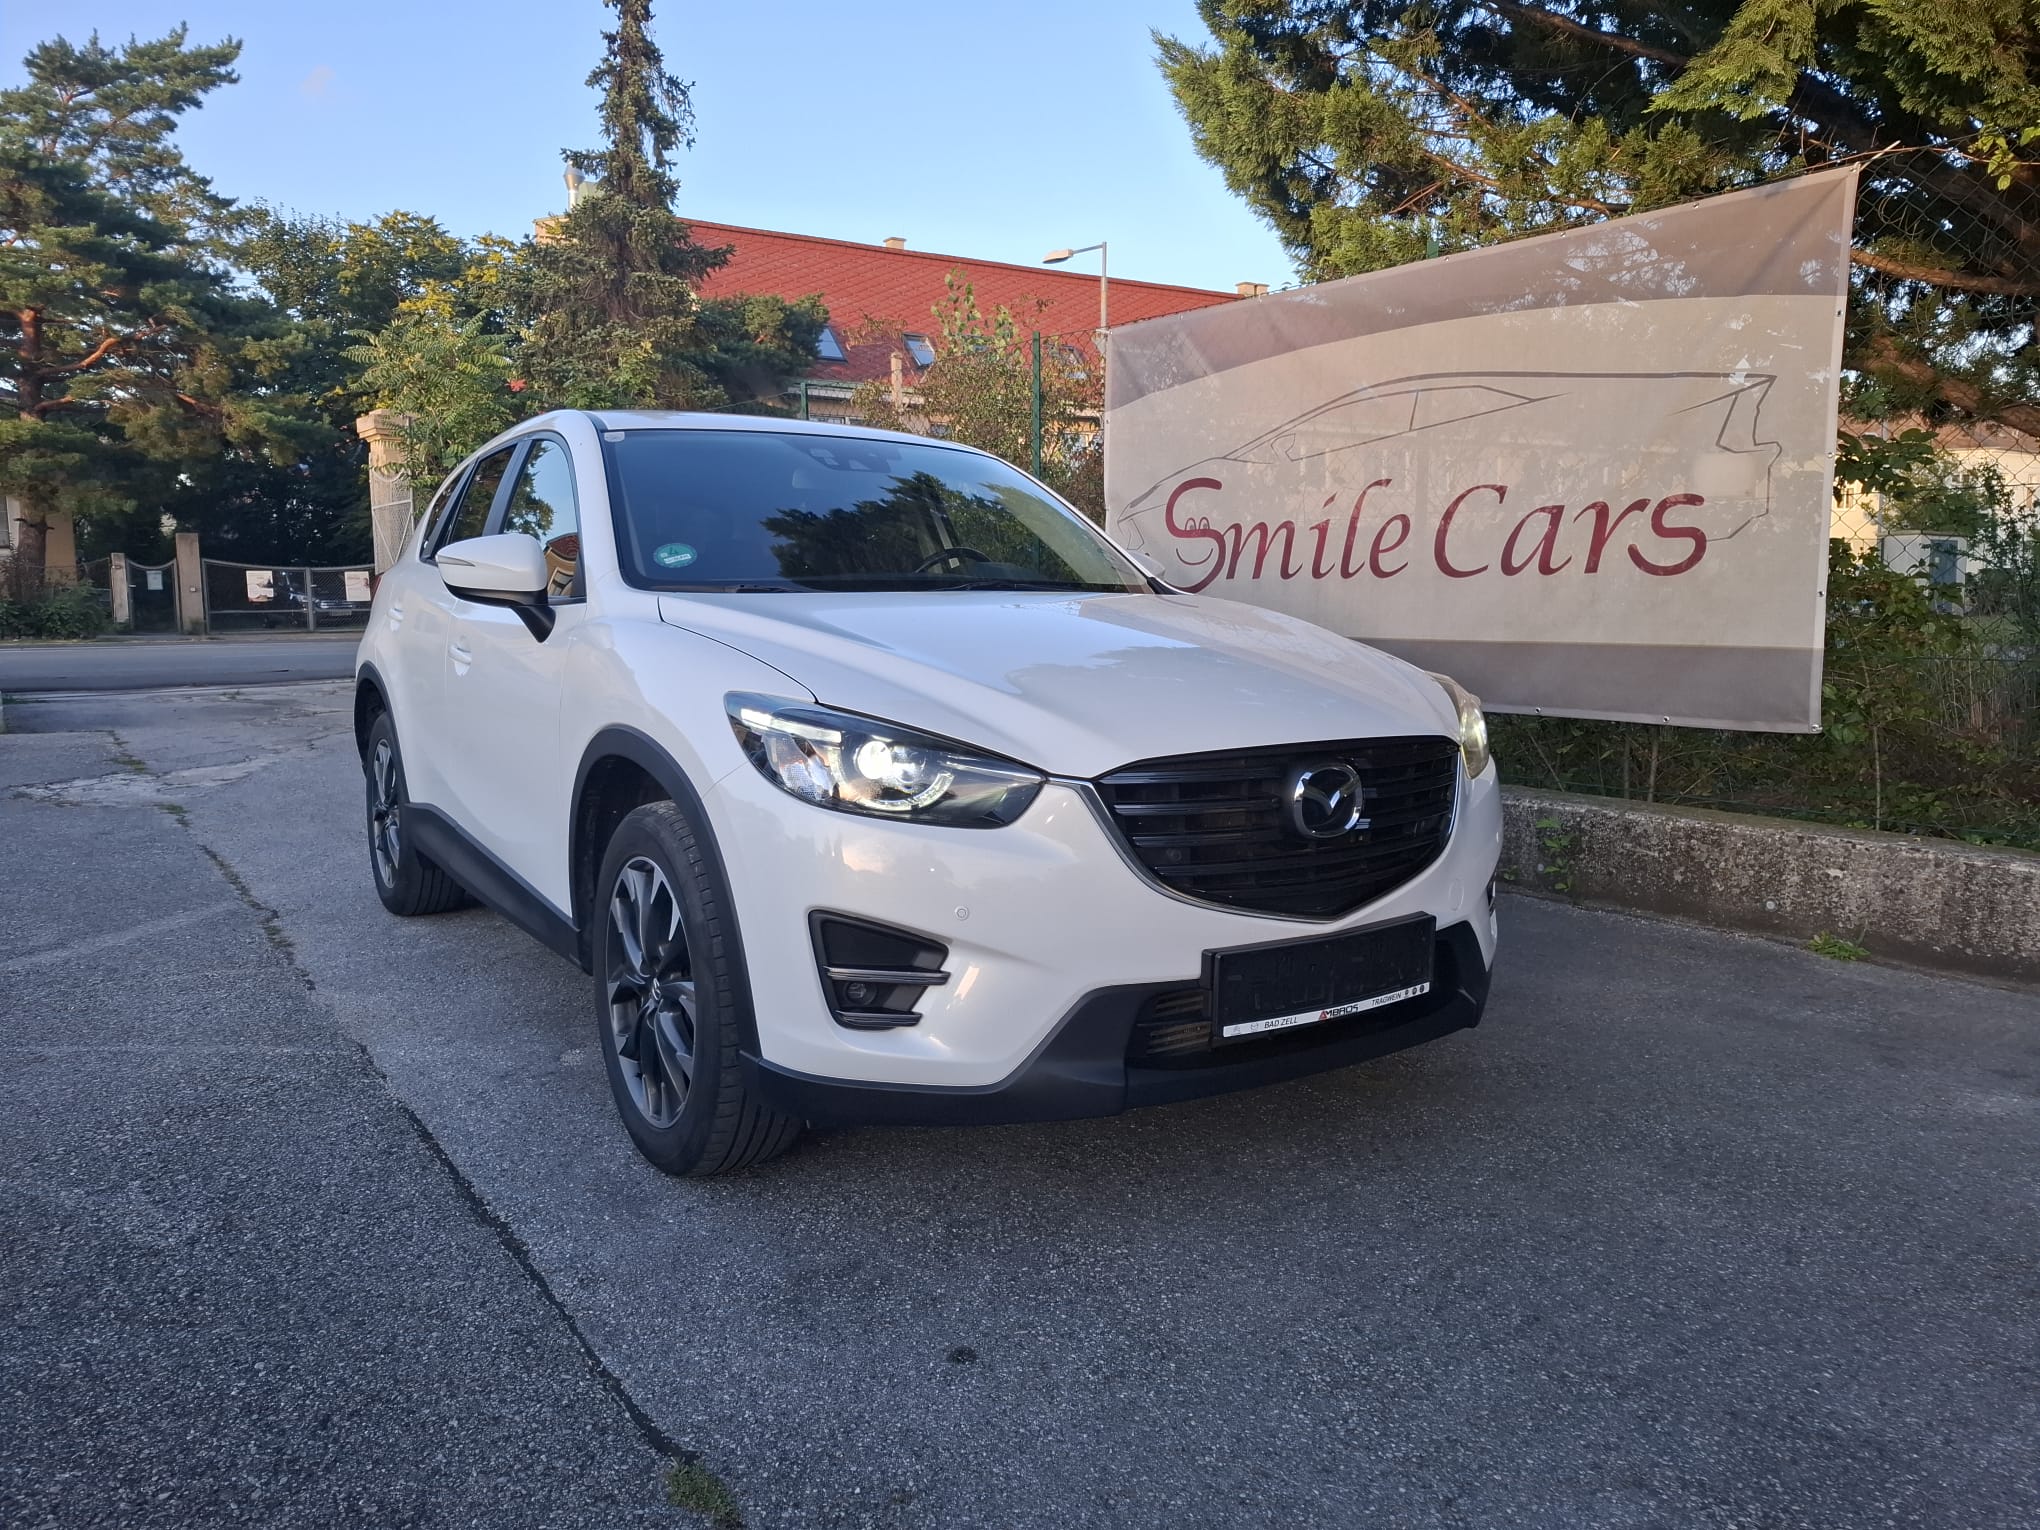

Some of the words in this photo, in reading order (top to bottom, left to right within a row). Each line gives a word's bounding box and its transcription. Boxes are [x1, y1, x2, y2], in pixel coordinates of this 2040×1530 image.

[1165, 477, 1411, 594] Smile
[1433, 484, 1707, 578] Cars
[1264, 1019, 1280, 1029] BAD
[1280, 1016, 1298, 1026] ZELL
